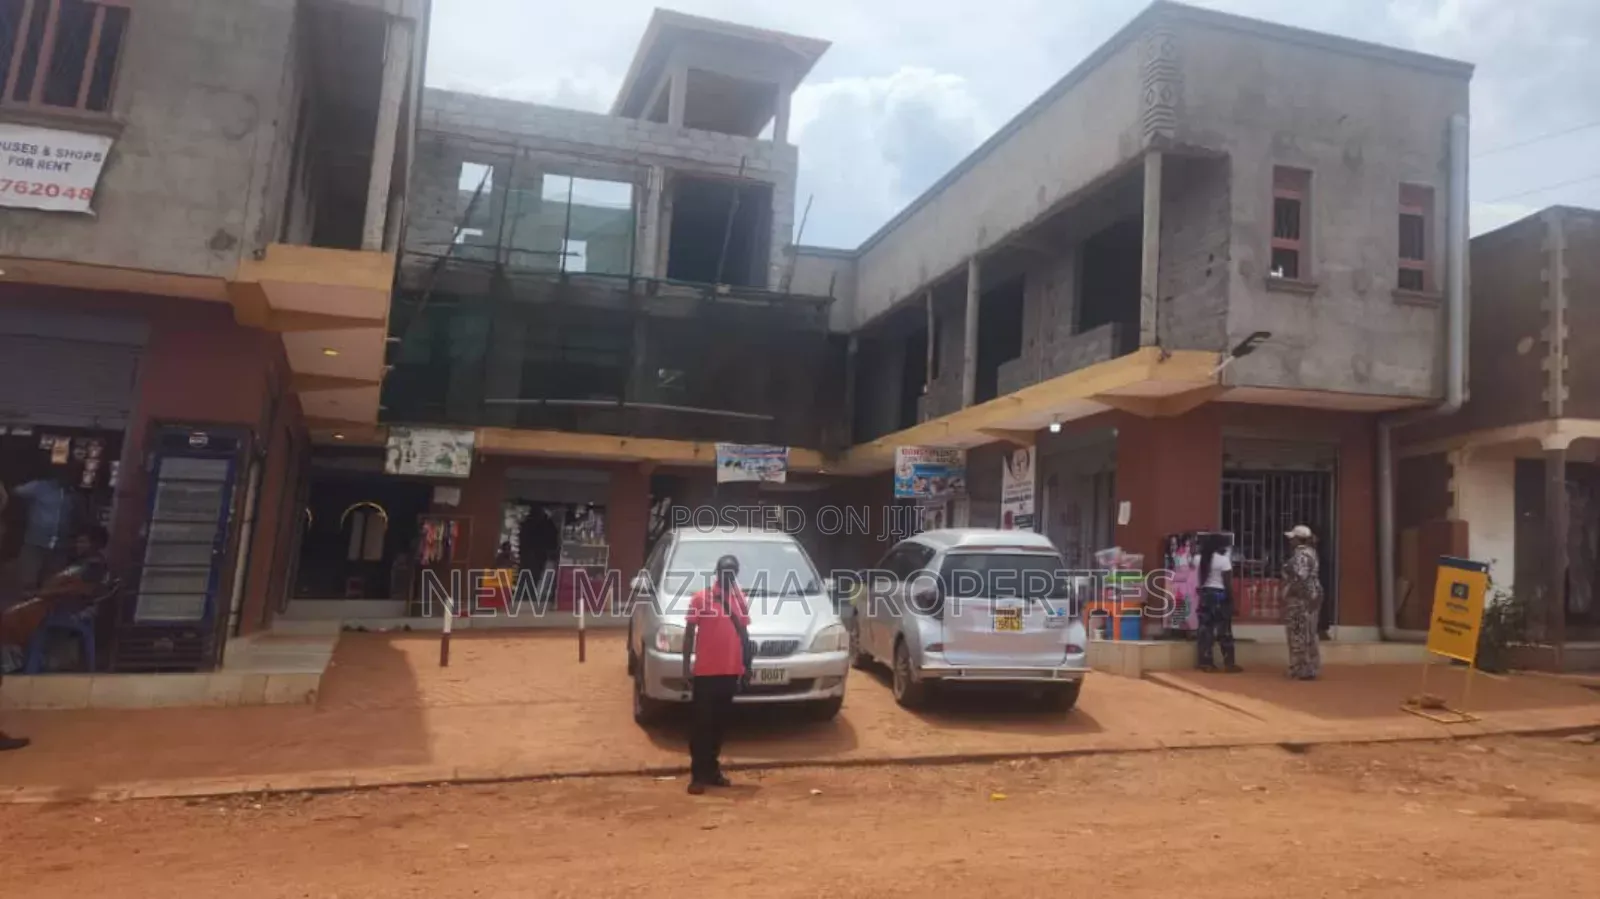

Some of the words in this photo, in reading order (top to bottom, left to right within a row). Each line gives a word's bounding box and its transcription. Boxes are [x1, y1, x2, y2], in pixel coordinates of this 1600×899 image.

[0, 141, 38, 154] USES
[56, 149, 102, 162] SHOPS
[8, 157, 34, 168] FOR
[37, 161, 72, 172] RENT
